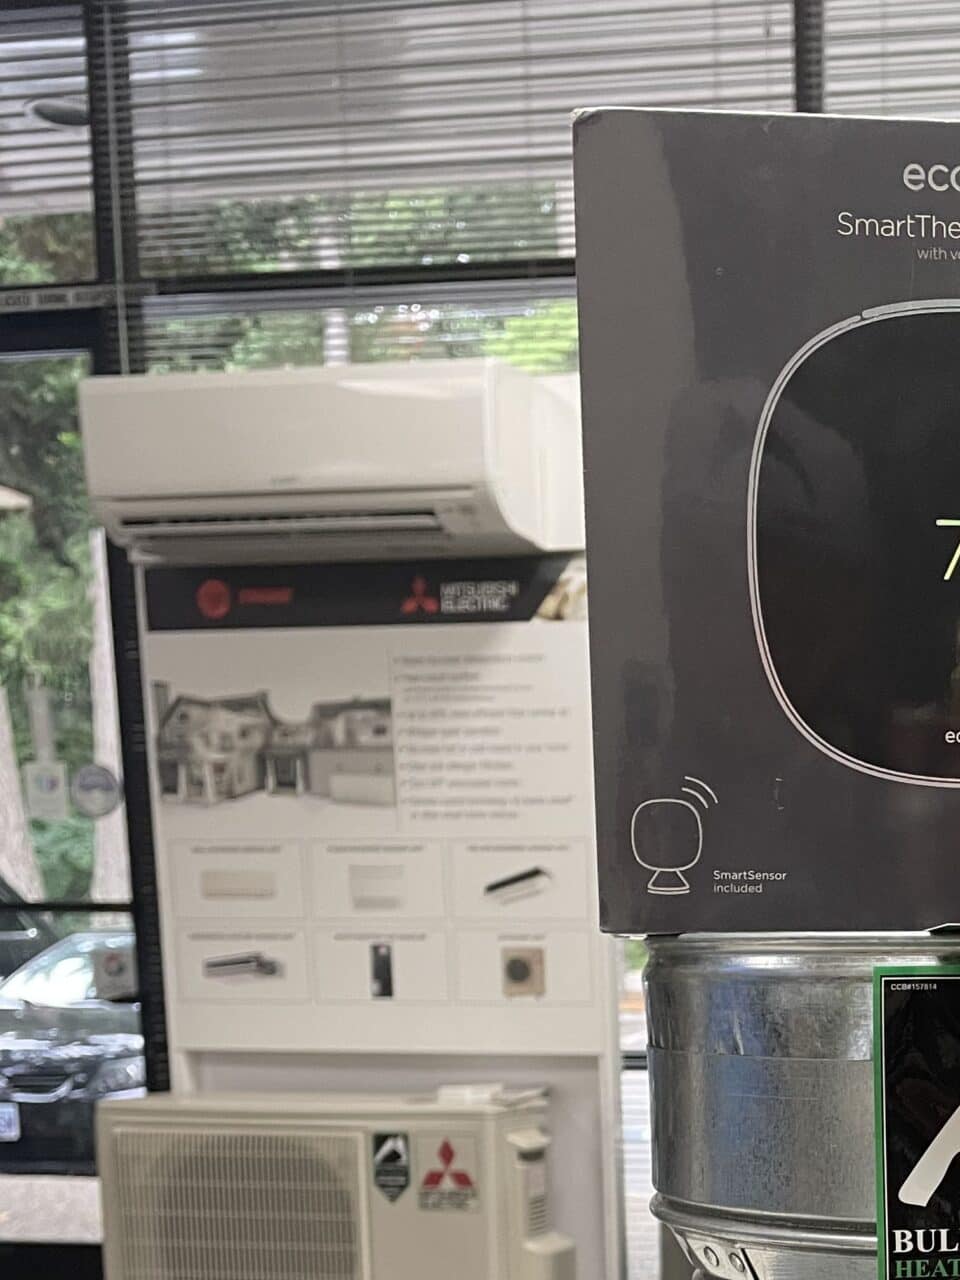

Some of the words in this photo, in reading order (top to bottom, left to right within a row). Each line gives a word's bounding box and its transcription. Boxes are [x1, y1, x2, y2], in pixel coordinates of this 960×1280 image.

[916, 248, 947, 261] with
[712, 869, 787, 881] SmartSensor
[713, 883, 764, 894] included
